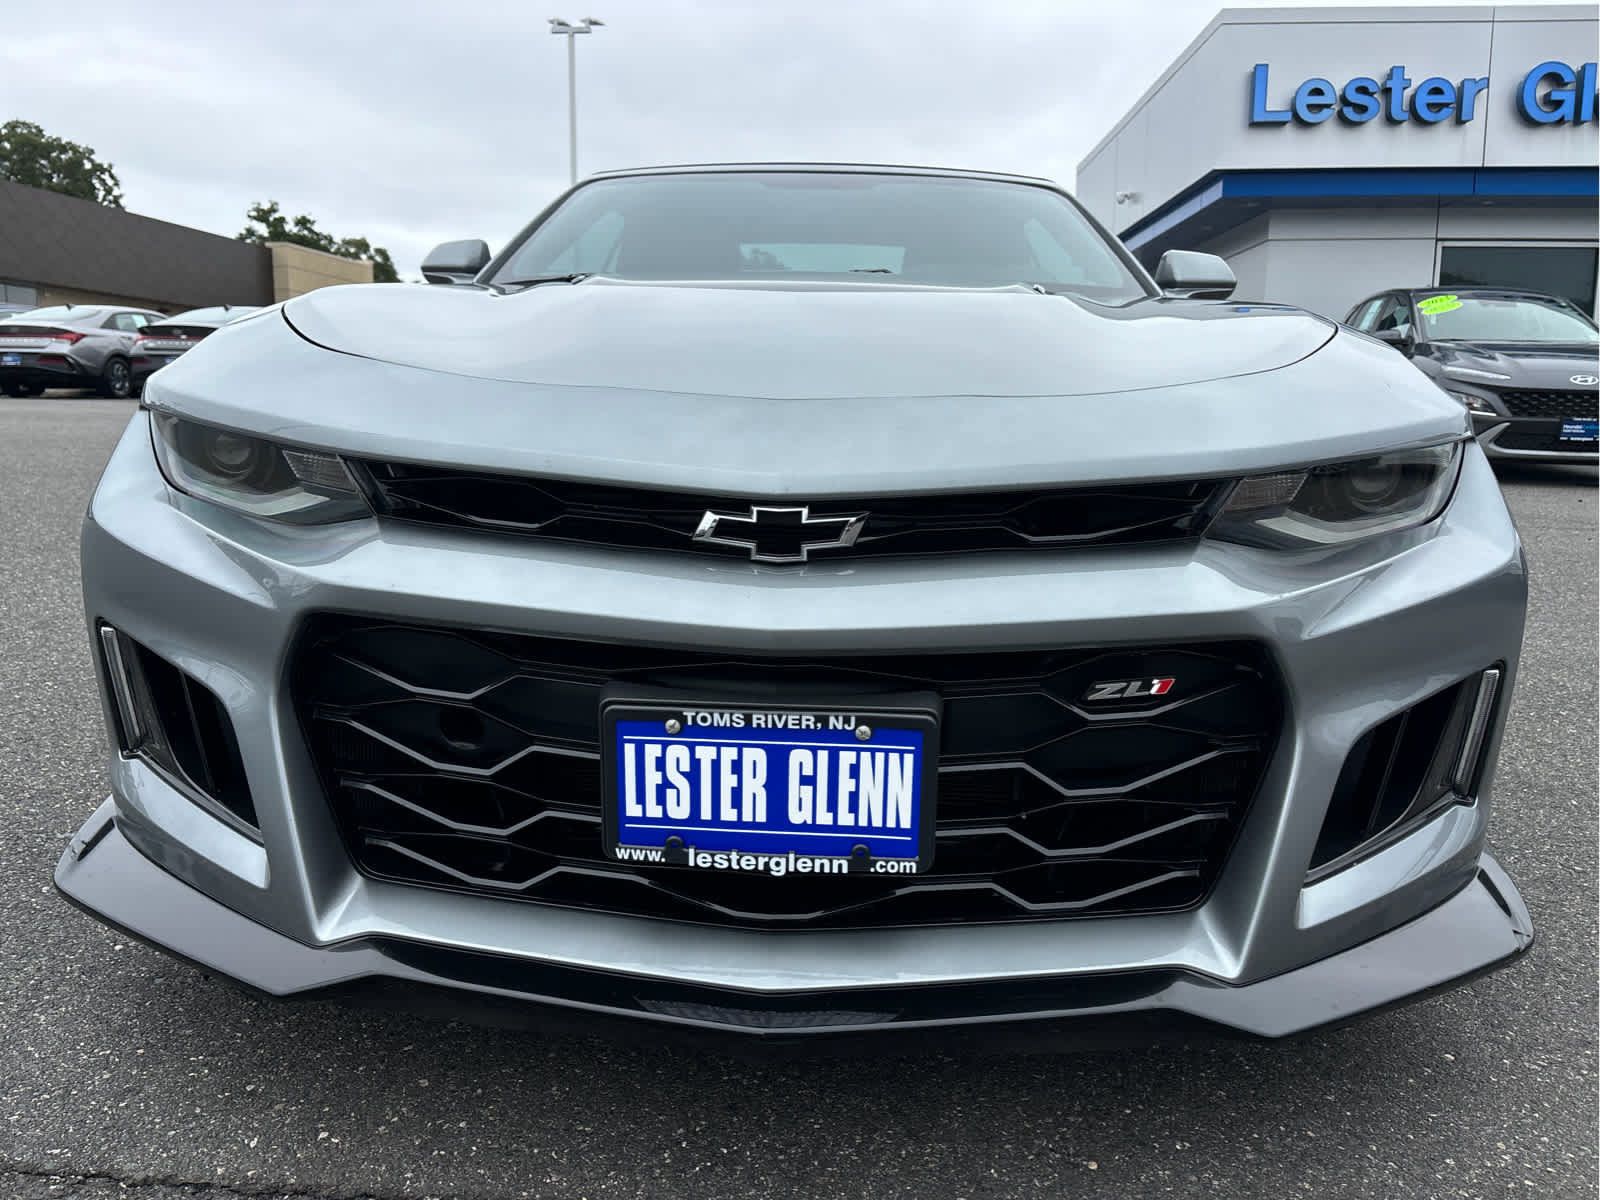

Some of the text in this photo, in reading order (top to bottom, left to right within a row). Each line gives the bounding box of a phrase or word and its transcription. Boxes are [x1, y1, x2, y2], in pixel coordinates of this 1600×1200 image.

[1250, 60, 1599, 126] Lester Gl
[1087, 678, 1176, 700] ZL1
[683, 711, 856, 731] TOMS RIVER, NJ
[623, 742, 914, 829] LESTER GLENN
[615, 847, 917, 877] www. lesterglenn .com
